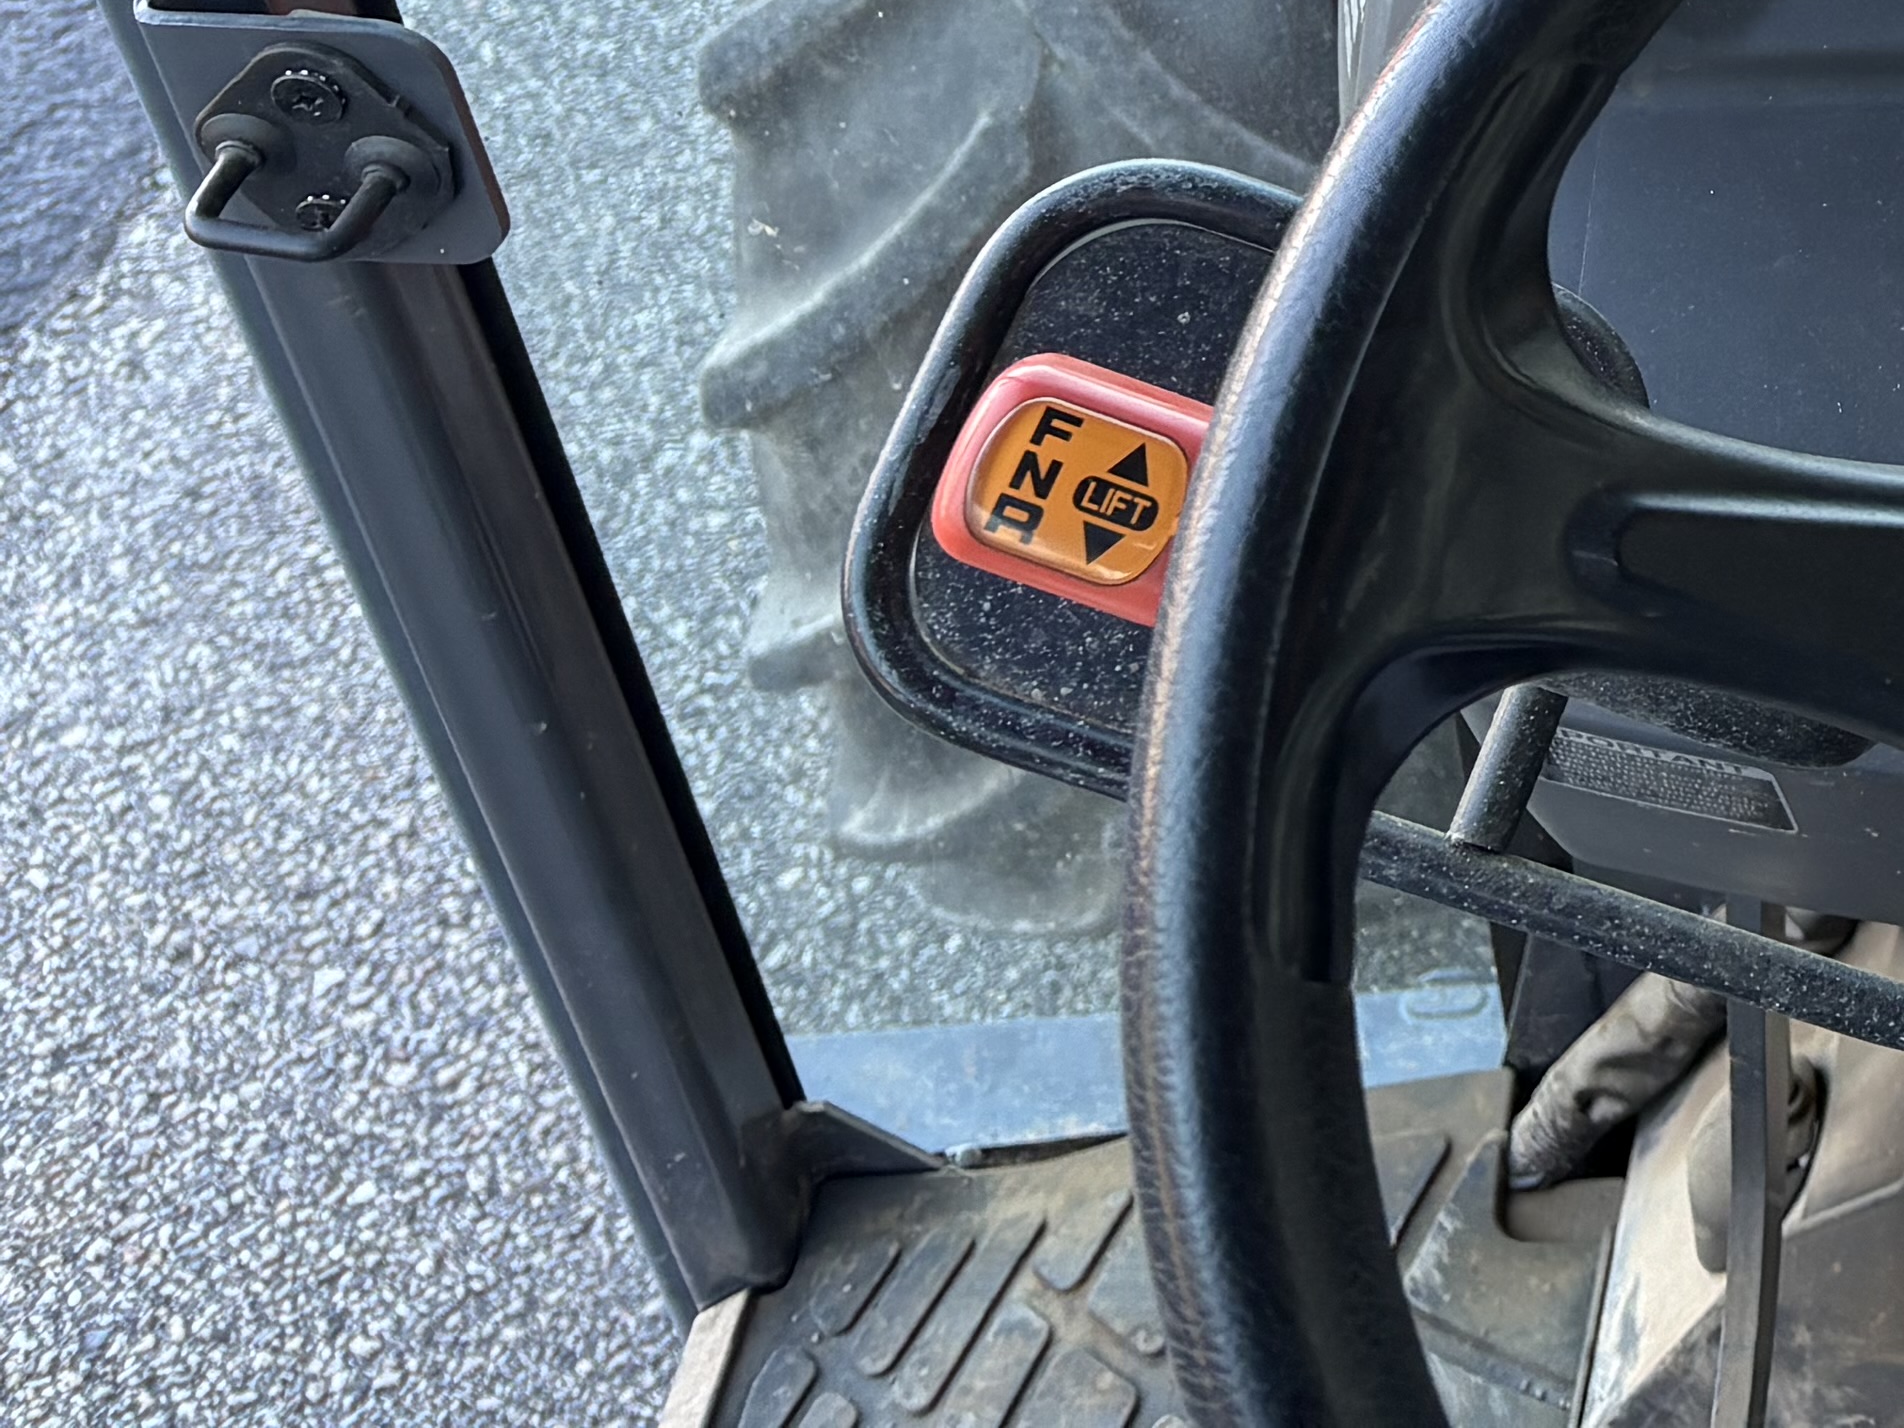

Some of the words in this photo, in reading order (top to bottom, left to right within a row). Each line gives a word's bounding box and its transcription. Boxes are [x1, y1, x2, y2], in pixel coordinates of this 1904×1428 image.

[1029, 405, 1085, 446] F
[1009, 449, 1064, 500] N
[984, 492, 1045, 545] R
[1080, 481, 1152, 525] LIFT
[1559, 728, 1743, 776] PORTANT
